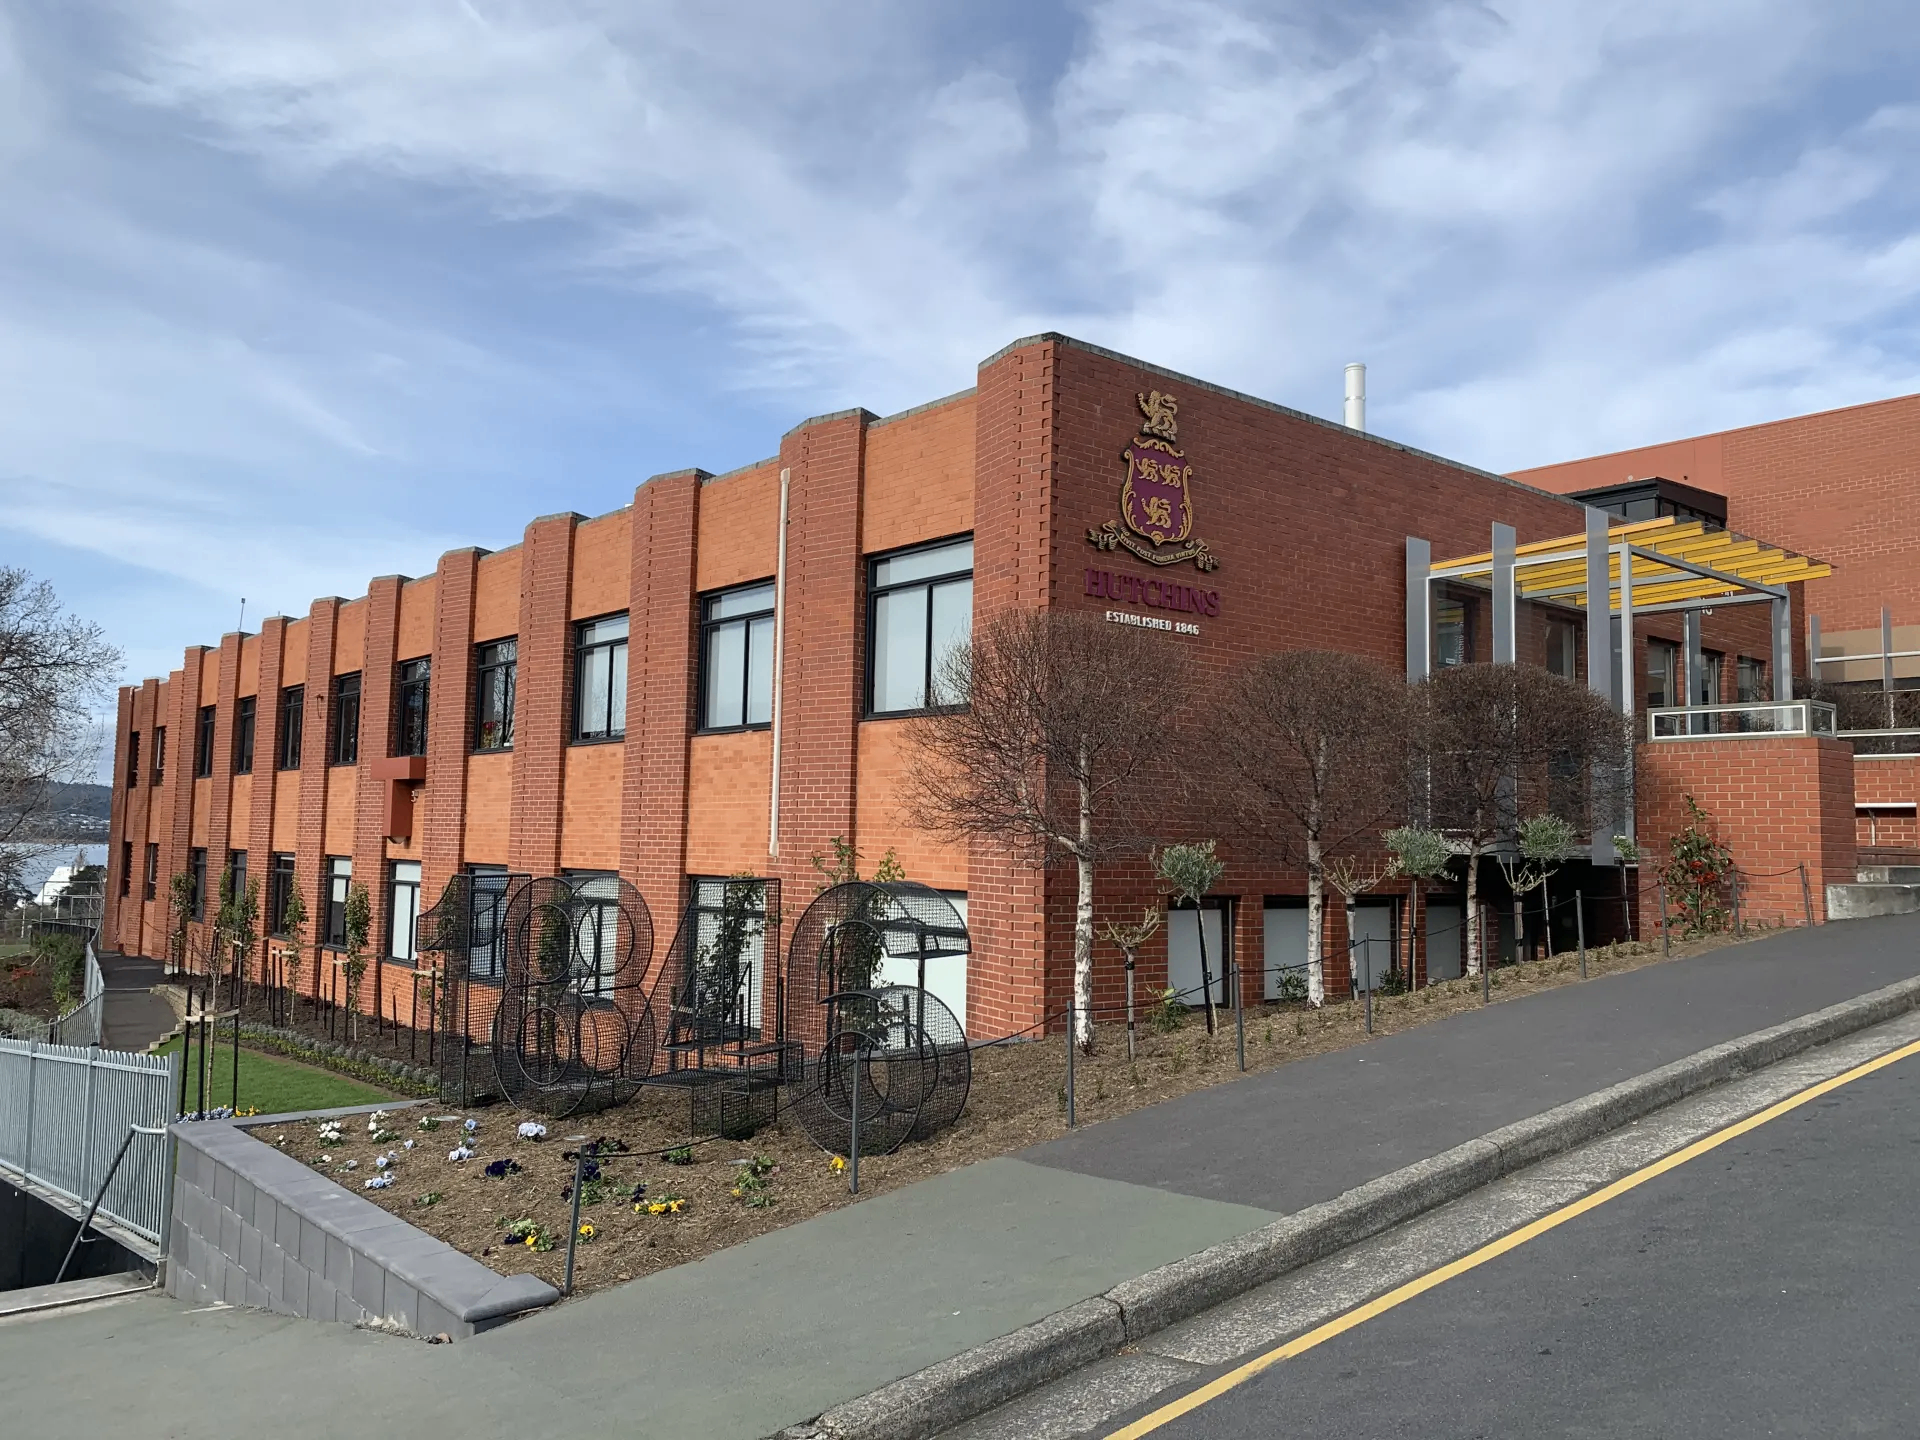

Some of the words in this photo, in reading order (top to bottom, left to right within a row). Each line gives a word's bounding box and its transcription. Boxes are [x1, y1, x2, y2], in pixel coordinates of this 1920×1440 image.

[1136, 546, 1152, 558] POST
[1084, 568, 1220, 617] HUTCHINS
[1105, 610, 1172, 631] ESTABLISHED
[1174, 622, 1200, 635] 1846
[416, 873, 973, 1157] 1846
